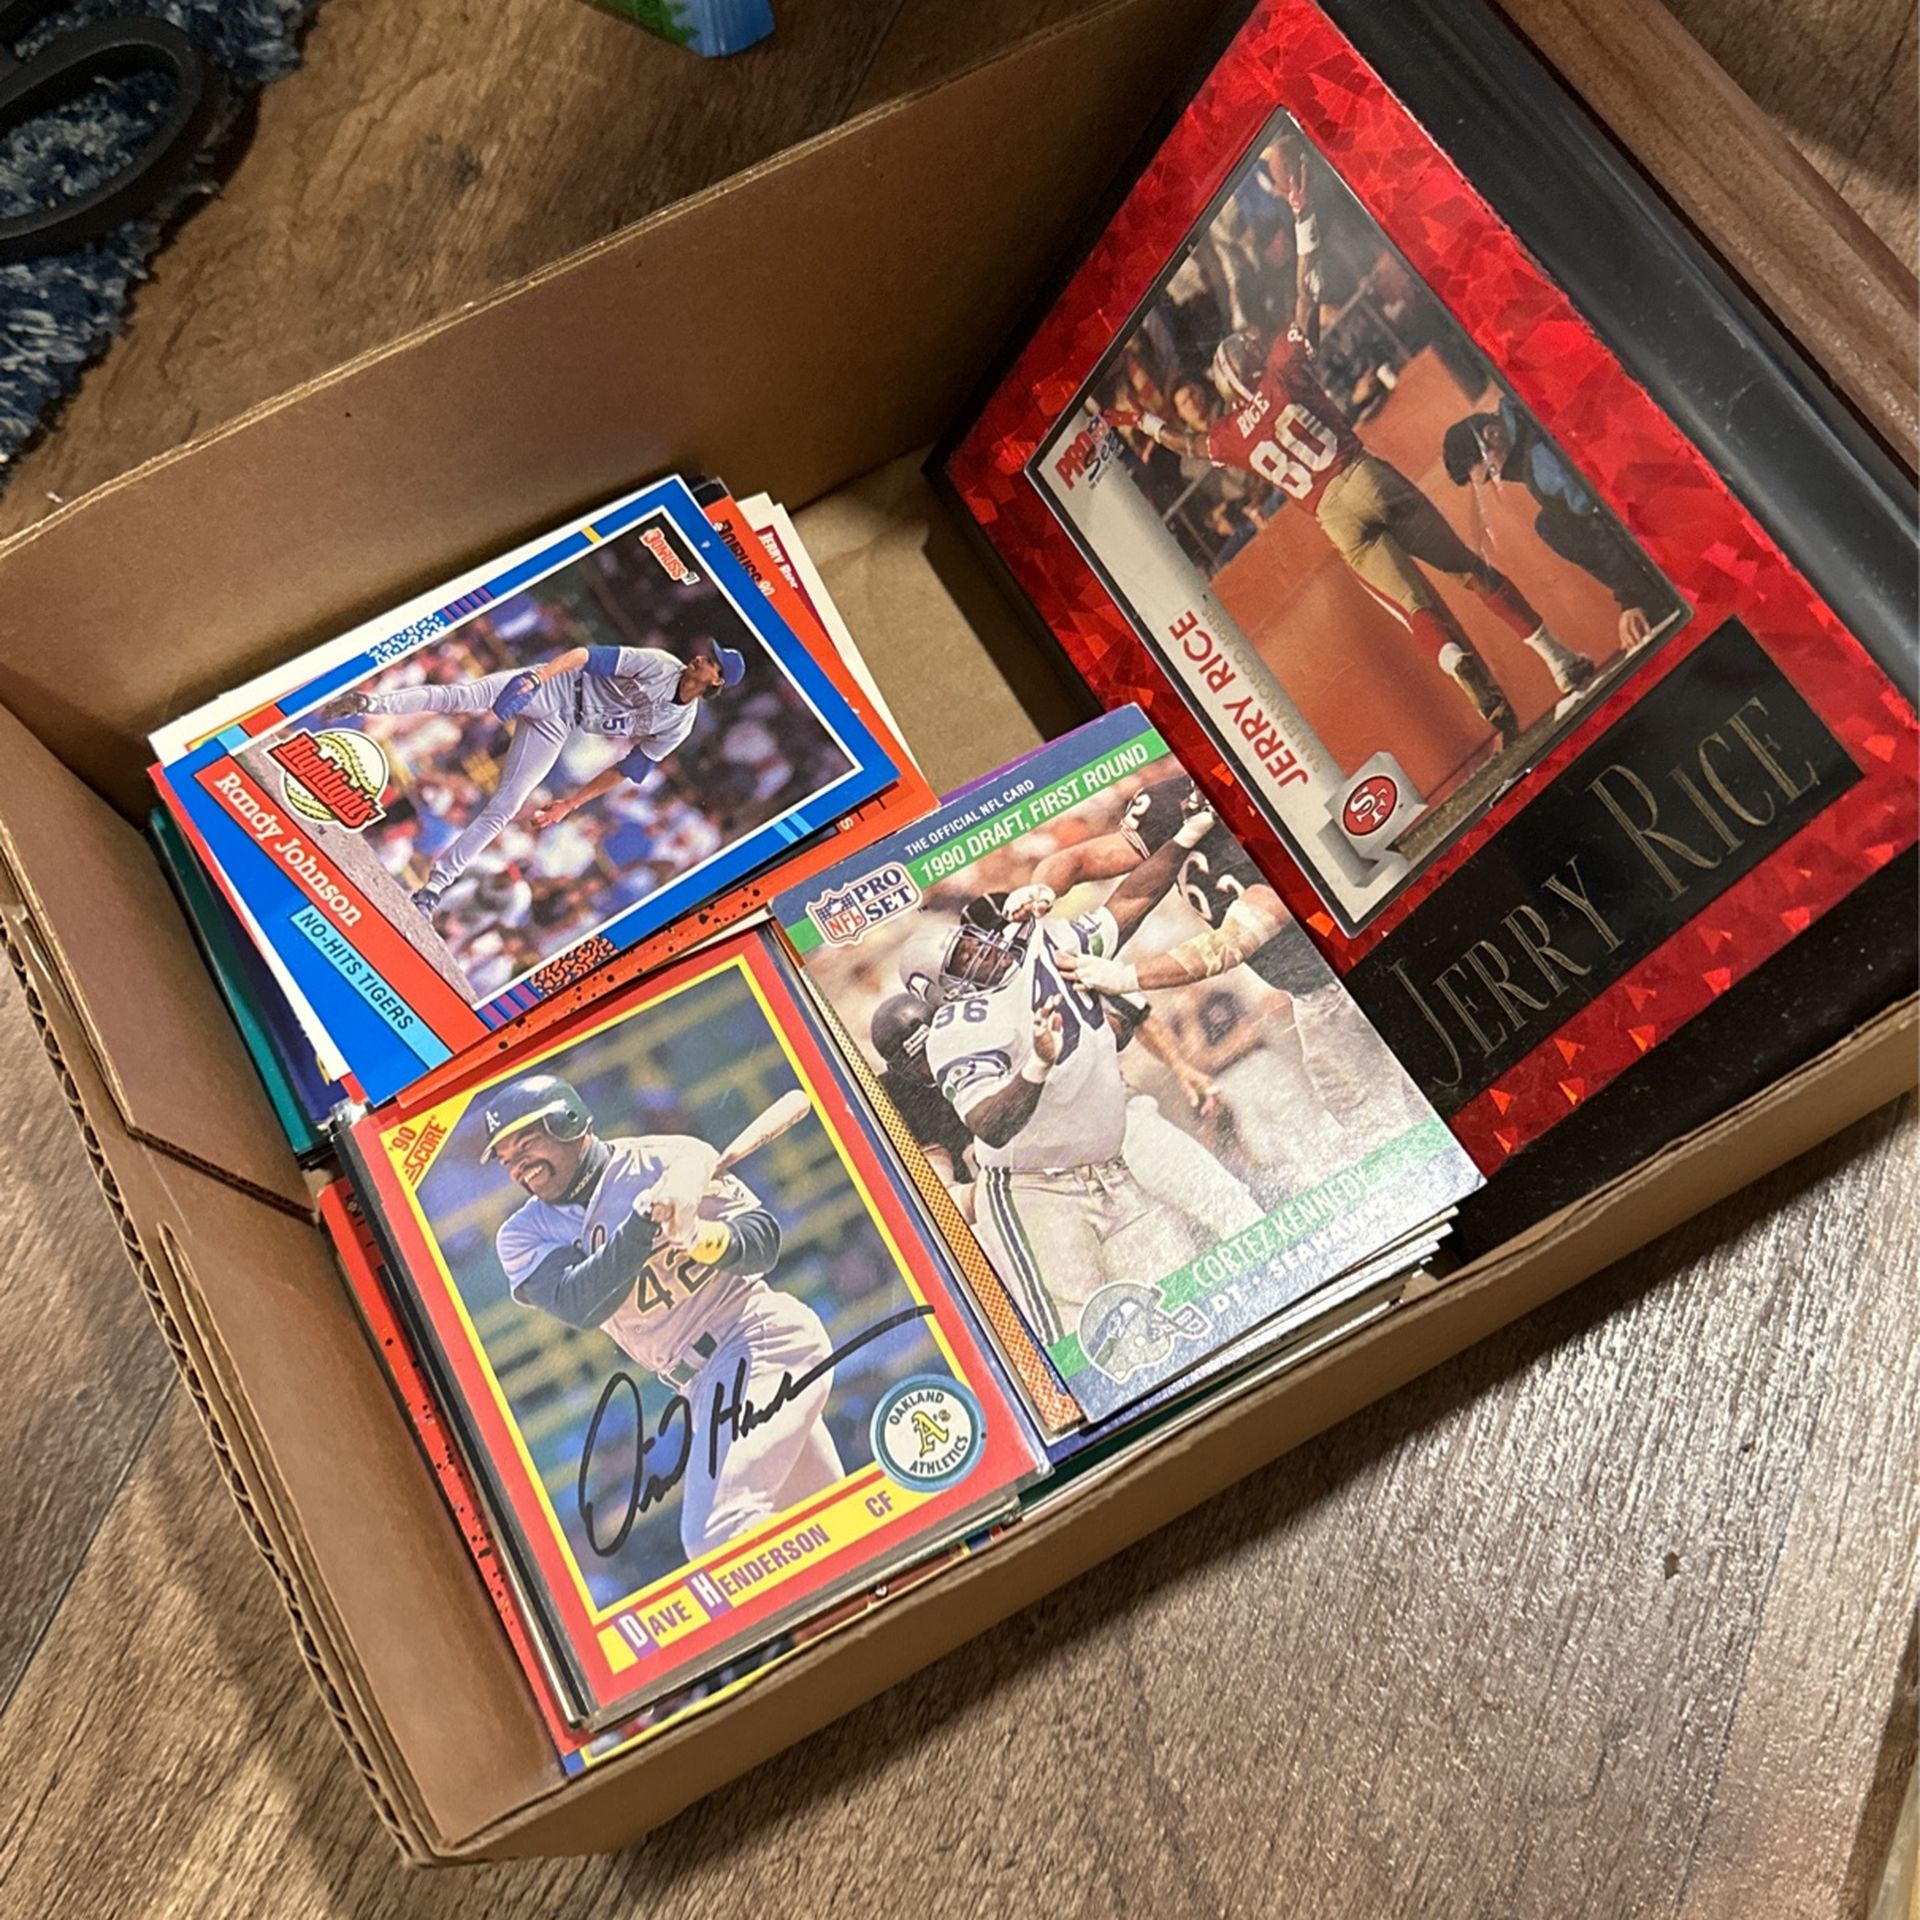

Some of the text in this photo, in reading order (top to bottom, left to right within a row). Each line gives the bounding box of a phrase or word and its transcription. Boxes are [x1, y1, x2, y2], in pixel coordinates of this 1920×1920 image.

[1249, 403, 1338, 500] 80
[758, 531, 786, 564] JERRY
[1168, 610, 1309, 788] JERRY RICE
[215, 772, 363, 927] Randy Johnson
[905, 779, 1035, 857] THE OFFICIAL NFL CARD
[921, 743, 1149, 882] 1990 DRAFT, FIRST ROUND
[827, 909, 863, 936] NFL
[852, 868, 902, 902] PRO
[865, 885, 912, 922] SET
[1388, 696, 1822, 1088] JERRY RICE
[300, 912, 414, 1030] NO-HITS TIGERS
[934, 999, 989, 1029] 96
[404, 1120, 448, 1186] SCORE
[1192, 1165, 1371, 1288] CORTEZ KENNEDY
[637, 1240, 717, 1315] 42
[889, 1391, 945, 1425] OAKLAND
[909, 1435, 968, 1474] ATHLETICS
[618, 1490, 895, 1648] DAVE HENDERSON CF
